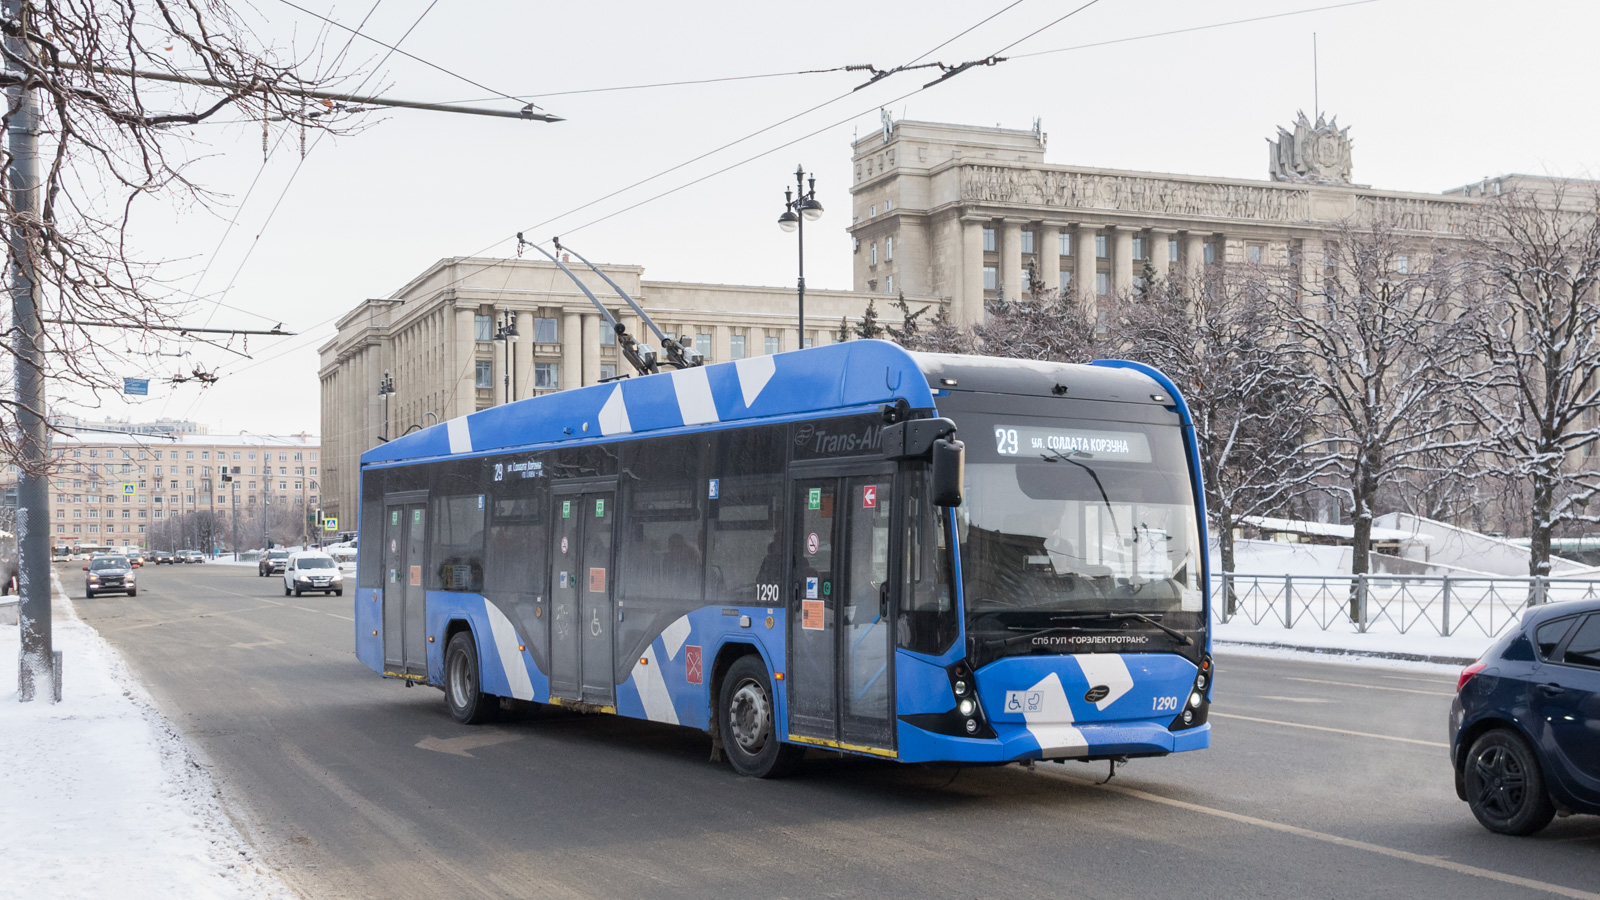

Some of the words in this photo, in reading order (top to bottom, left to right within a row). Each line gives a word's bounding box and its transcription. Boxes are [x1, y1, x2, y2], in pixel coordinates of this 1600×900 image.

[995, 428, 1019, 454] 29
[1047, 435, 1090, 451] СОЛДАТА
[1090, 438, 1129, 453] КОРЗУНА
[494, 463, 503, 481] 29
[756, 583, 779, 601] 1290
[1050, 636, 1067, 645] ГУП
[1068, 635, 1149, 645] «ГОРЭЛЕКТРОТРАНС»
[1152, 696, 1178, 711] 1290
